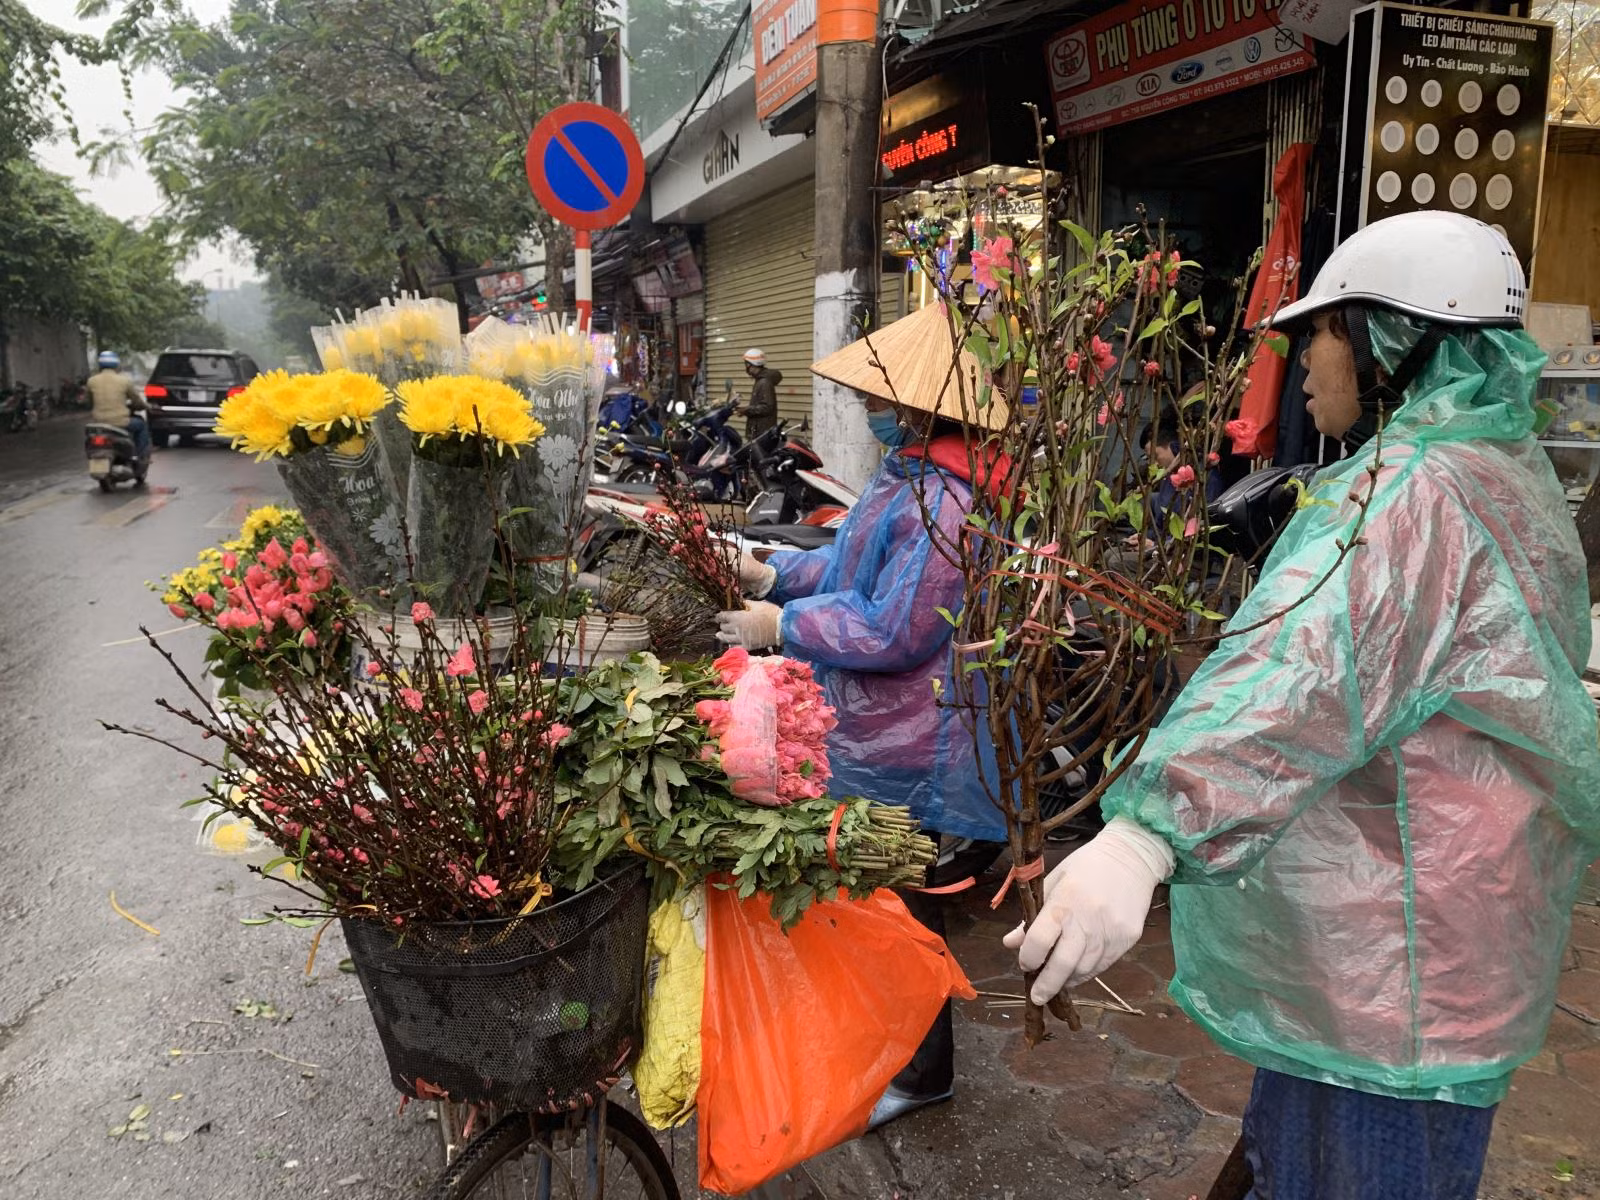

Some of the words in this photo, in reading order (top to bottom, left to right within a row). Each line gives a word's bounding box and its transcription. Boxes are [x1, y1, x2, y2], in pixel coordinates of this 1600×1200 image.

[1401, 12, 1425, 28] THIẾT
[1426, 16, 1436, 31] BỊ
[1437, 16, 1463, 32] CHIẾU
[1465, 20, 1489, 36] SÁNG
[1096, 23, 1129, 72] PHỤ
[1422, 33, 1439, 48] LED
[1479, 37, 1497, 53] CÁC
[1497, 41, 1517, 57] LOẠI
[1175, 65, 1198, 81] Ford
[1402, 54, 1415, 68] Uy
[1416, 55, 1430, 68] Tín
[1436, 56, 1456, 70] Chất
[1490, 62, 1507, 75] Bảo
[1508, 64, 1530, 77] Hành
